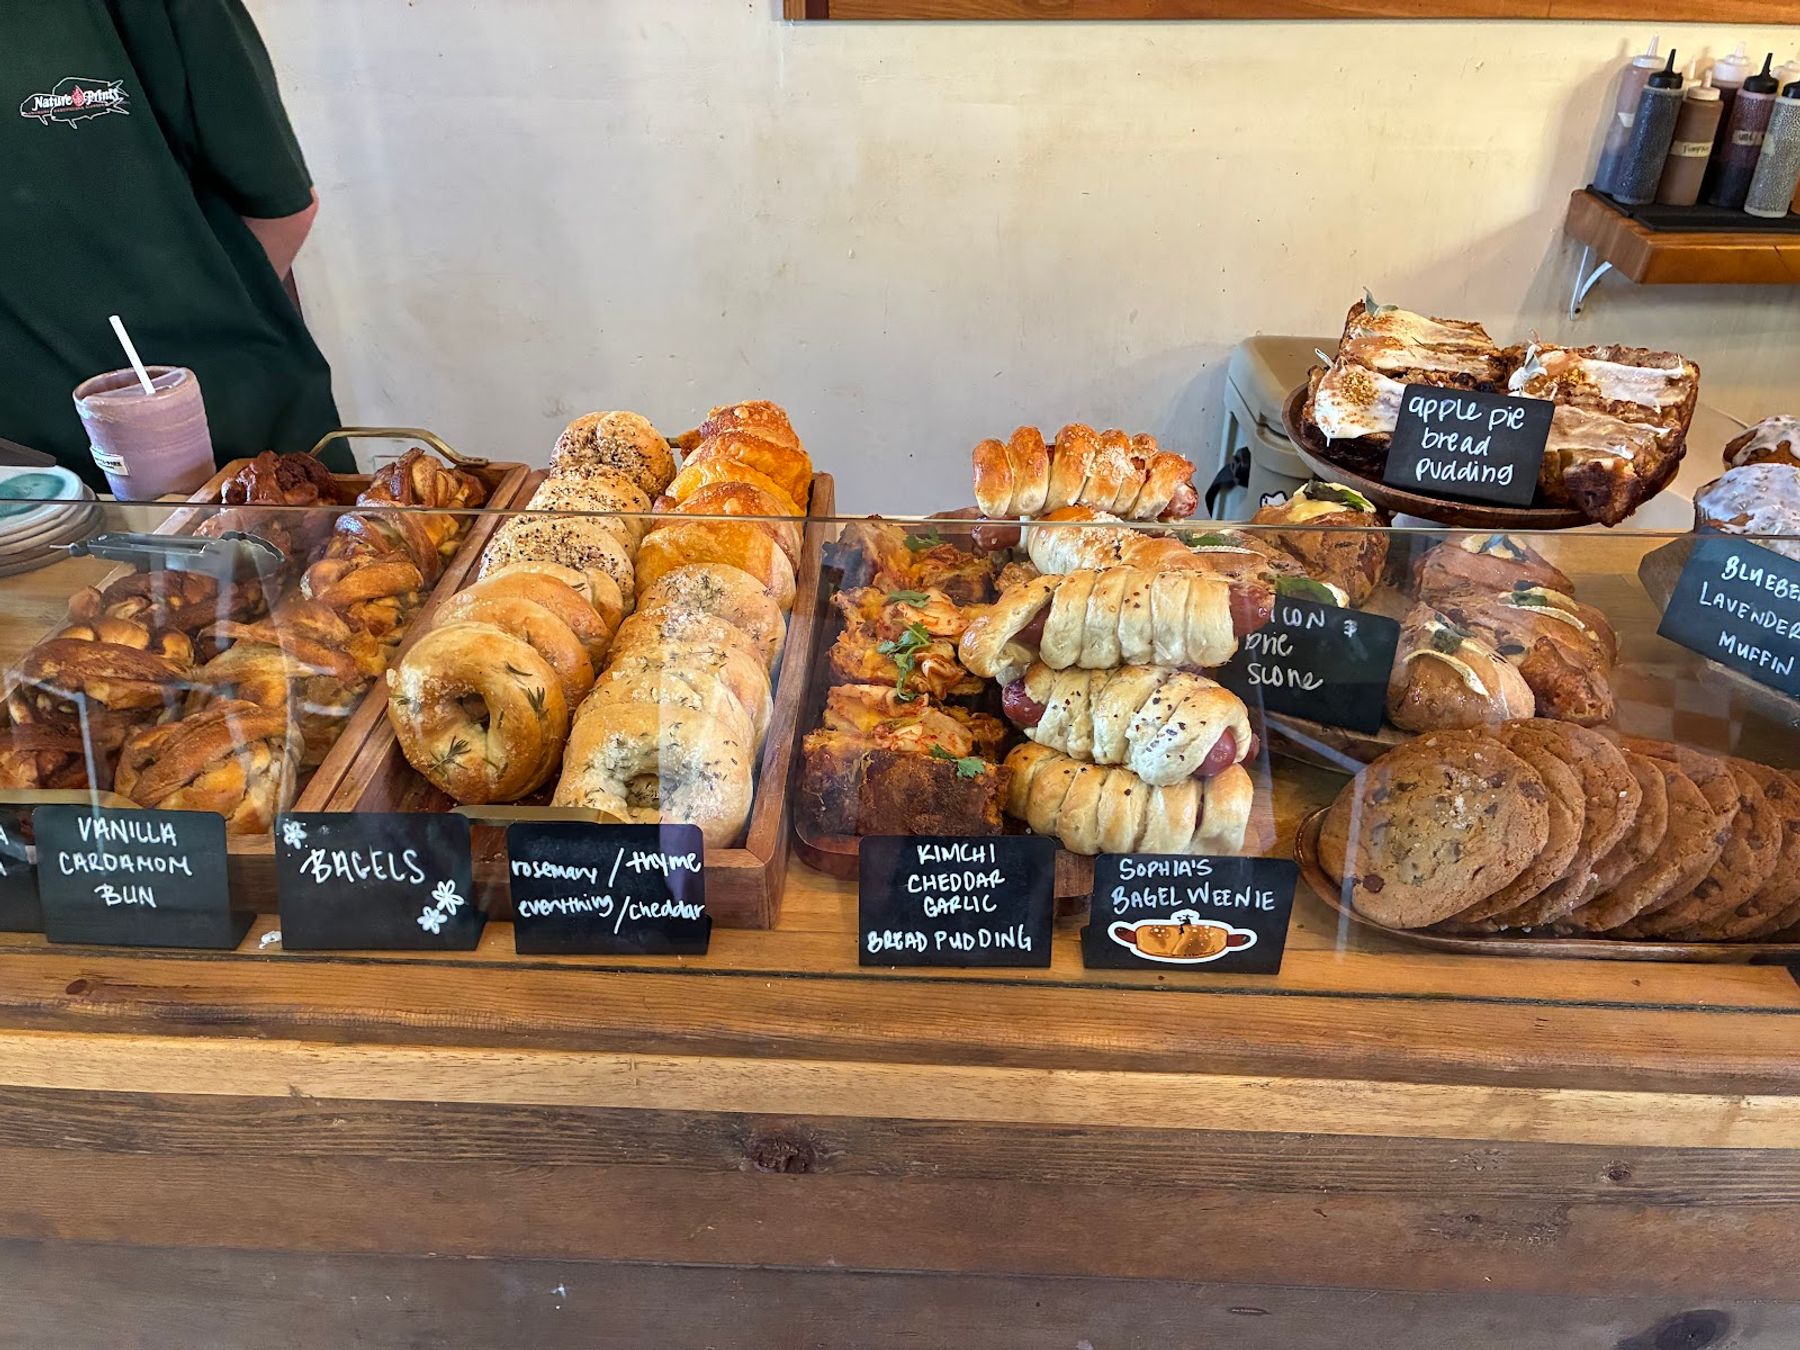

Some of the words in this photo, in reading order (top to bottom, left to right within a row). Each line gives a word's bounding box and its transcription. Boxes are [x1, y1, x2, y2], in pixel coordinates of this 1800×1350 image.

[32, 94, 72, 111] Nature
[84, 88, 119, 105] Prints
[1408, 396, 1482, 423] apple
[1488, 406, 1525, 431] pie
[1421, 427, 1491, 456] bread
[1721, 555, 1800, 602] BLUEBE
[1699, 581, 1800, 639] LAVENDER
[1718, 630, 1795, 676] MUFFIN
[78, 816, 177, 846] VANILLA
[58, 851, 193, 876] CARDAMOM
[300, 848, 426, 884] BAGELS
[625, 851, 701, 877] thyme
[917, 843, 996, 865] KIMCHI
[907, 869, 1006, 893] CHEDDAR
[1119, 858, 1213, 881] SOPHIA'S
[94, 883, 157, 908] BUN
[923, 894, 997, 918] GARLIC
[1110, 885, 1182, 915] BAGEL
[1186, 881, 1275, 911] WEENIE
[867, 929, 928, 953] BREAD
[933, 923, 1032, 952] PUDDING
